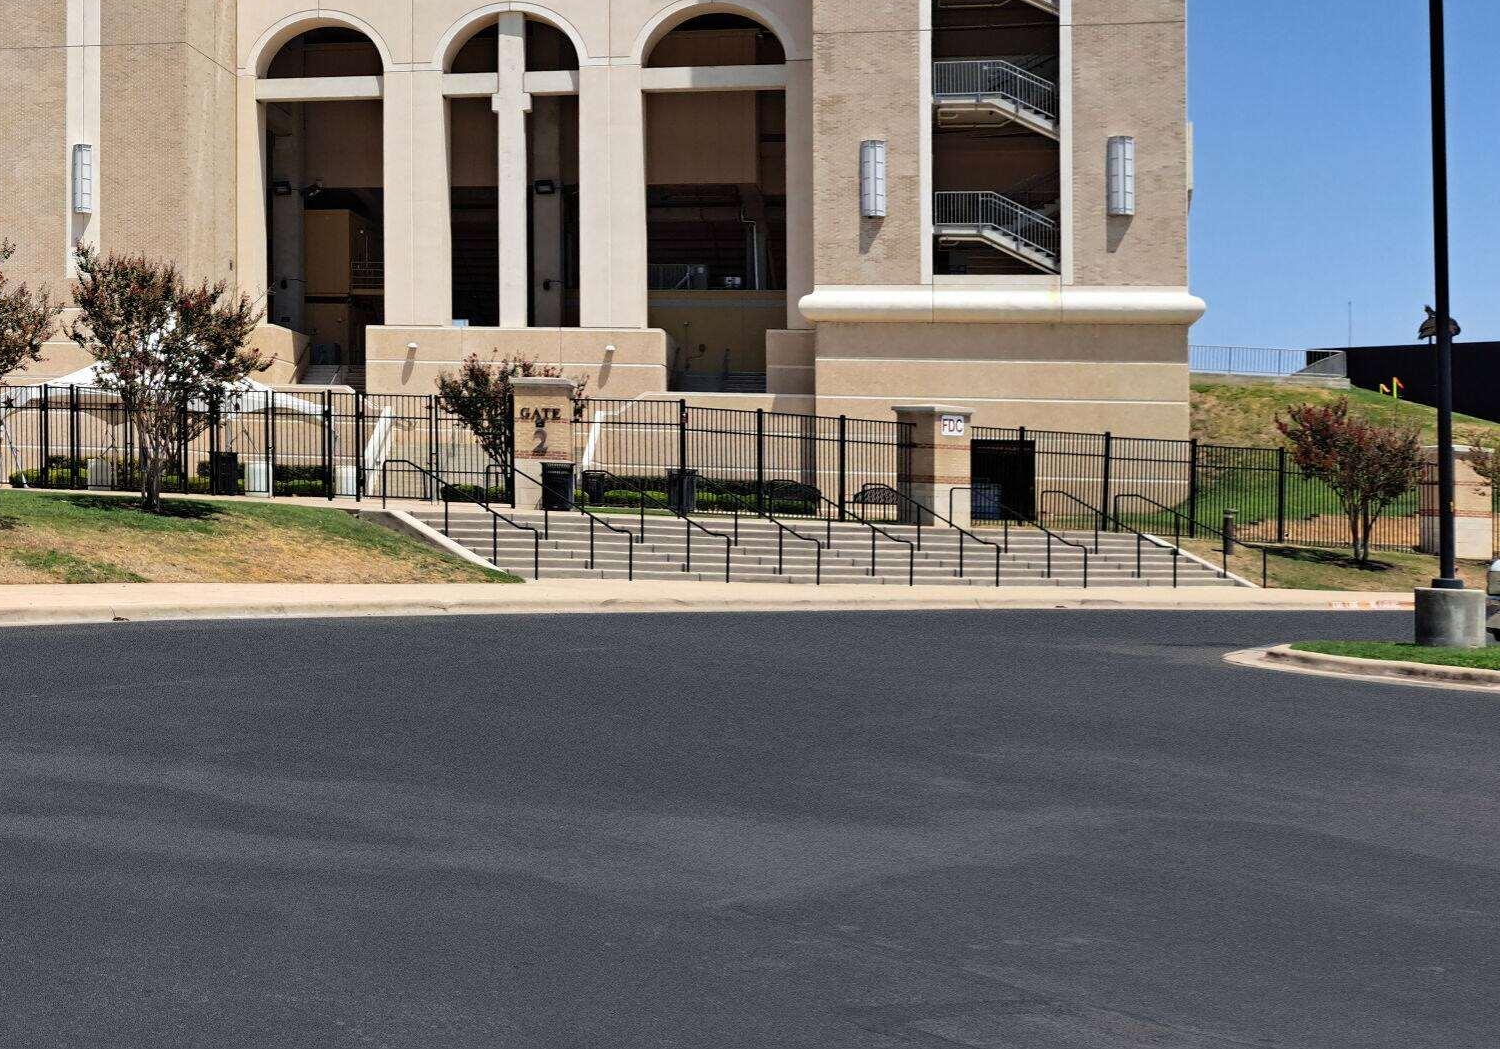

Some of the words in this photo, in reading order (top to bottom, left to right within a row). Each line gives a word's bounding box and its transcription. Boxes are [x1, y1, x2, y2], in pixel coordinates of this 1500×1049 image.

[520, 407, 561, 420] GATE
[943, 419, 962, 432] FDC
[532, 428, 548, 456] 2
